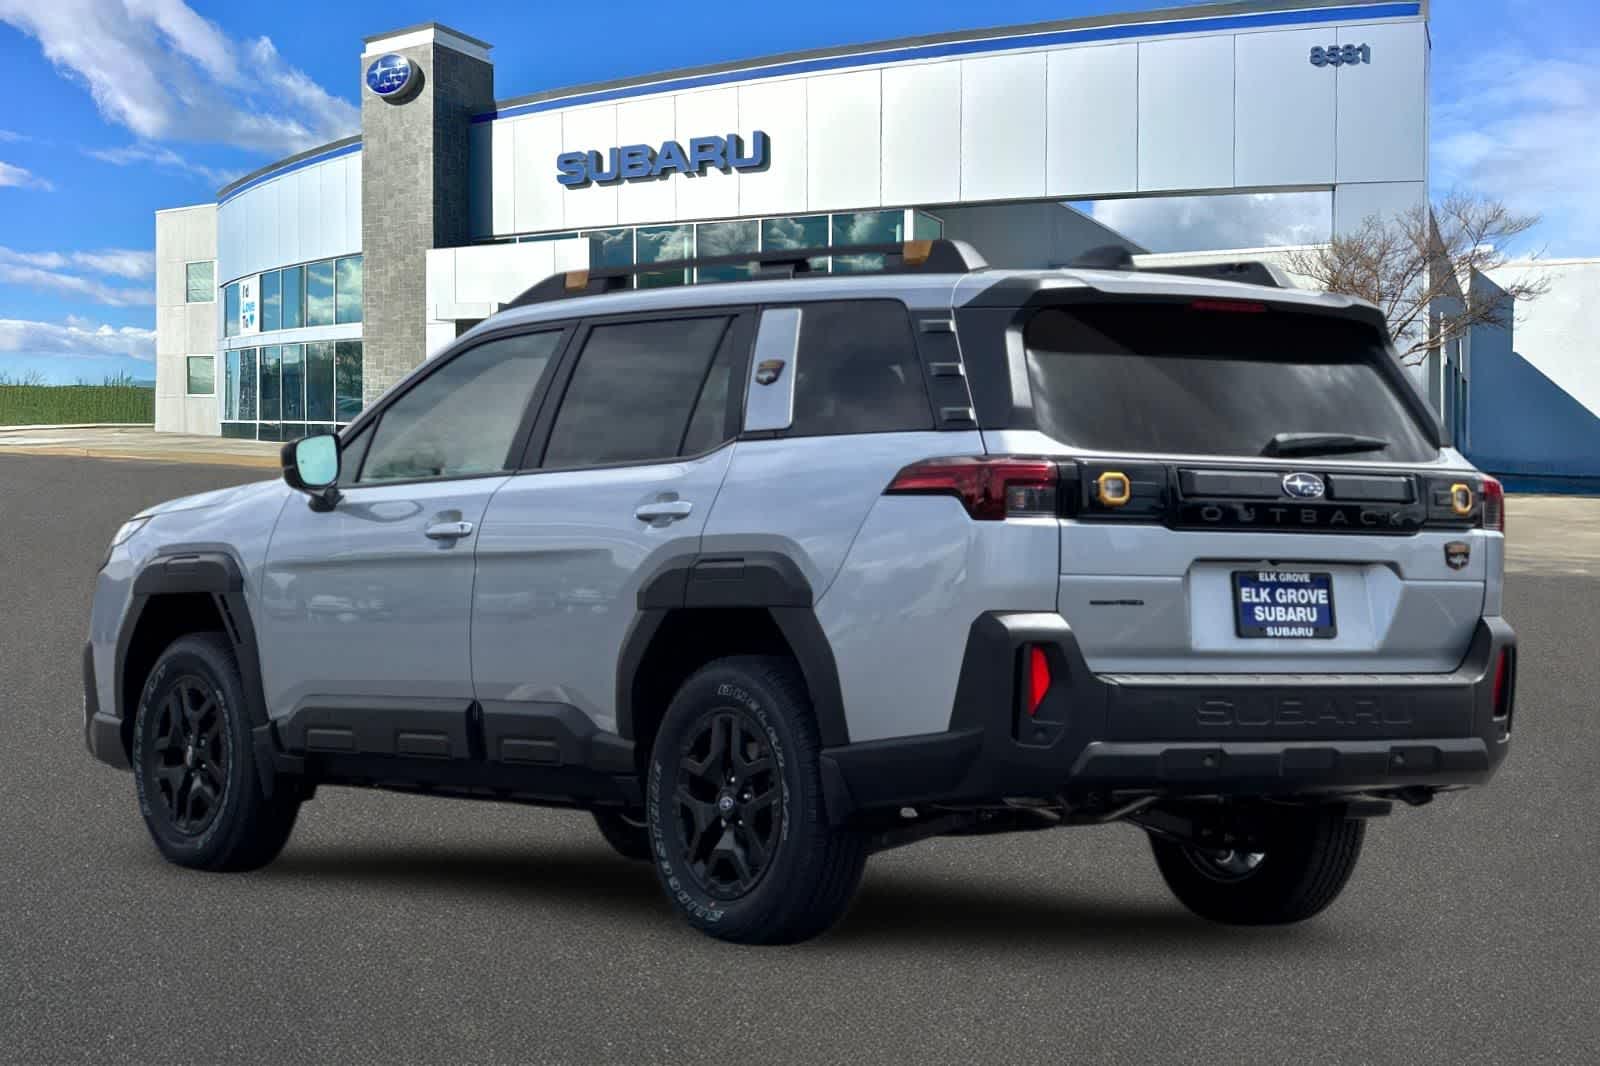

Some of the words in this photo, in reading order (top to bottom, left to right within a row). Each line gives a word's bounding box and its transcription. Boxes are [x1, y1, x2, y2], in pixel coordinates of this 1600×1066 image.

[556, 130, 768, 188] SUBARU
[1200, 504, 1402, 526] OUTBACK
[1258, 572, 1278, 583] ELK
[1279, 573, 1311, 583] GROVE
[1241, 587, 1272, 603] ELK
[1275, 588, 1329, 604] GROVE
[1254, 606, 1318, 622] SUBARU
[1266, 626, 1314, 637] SUBARU
[1194, 697, 1415, 727] SUBARU
